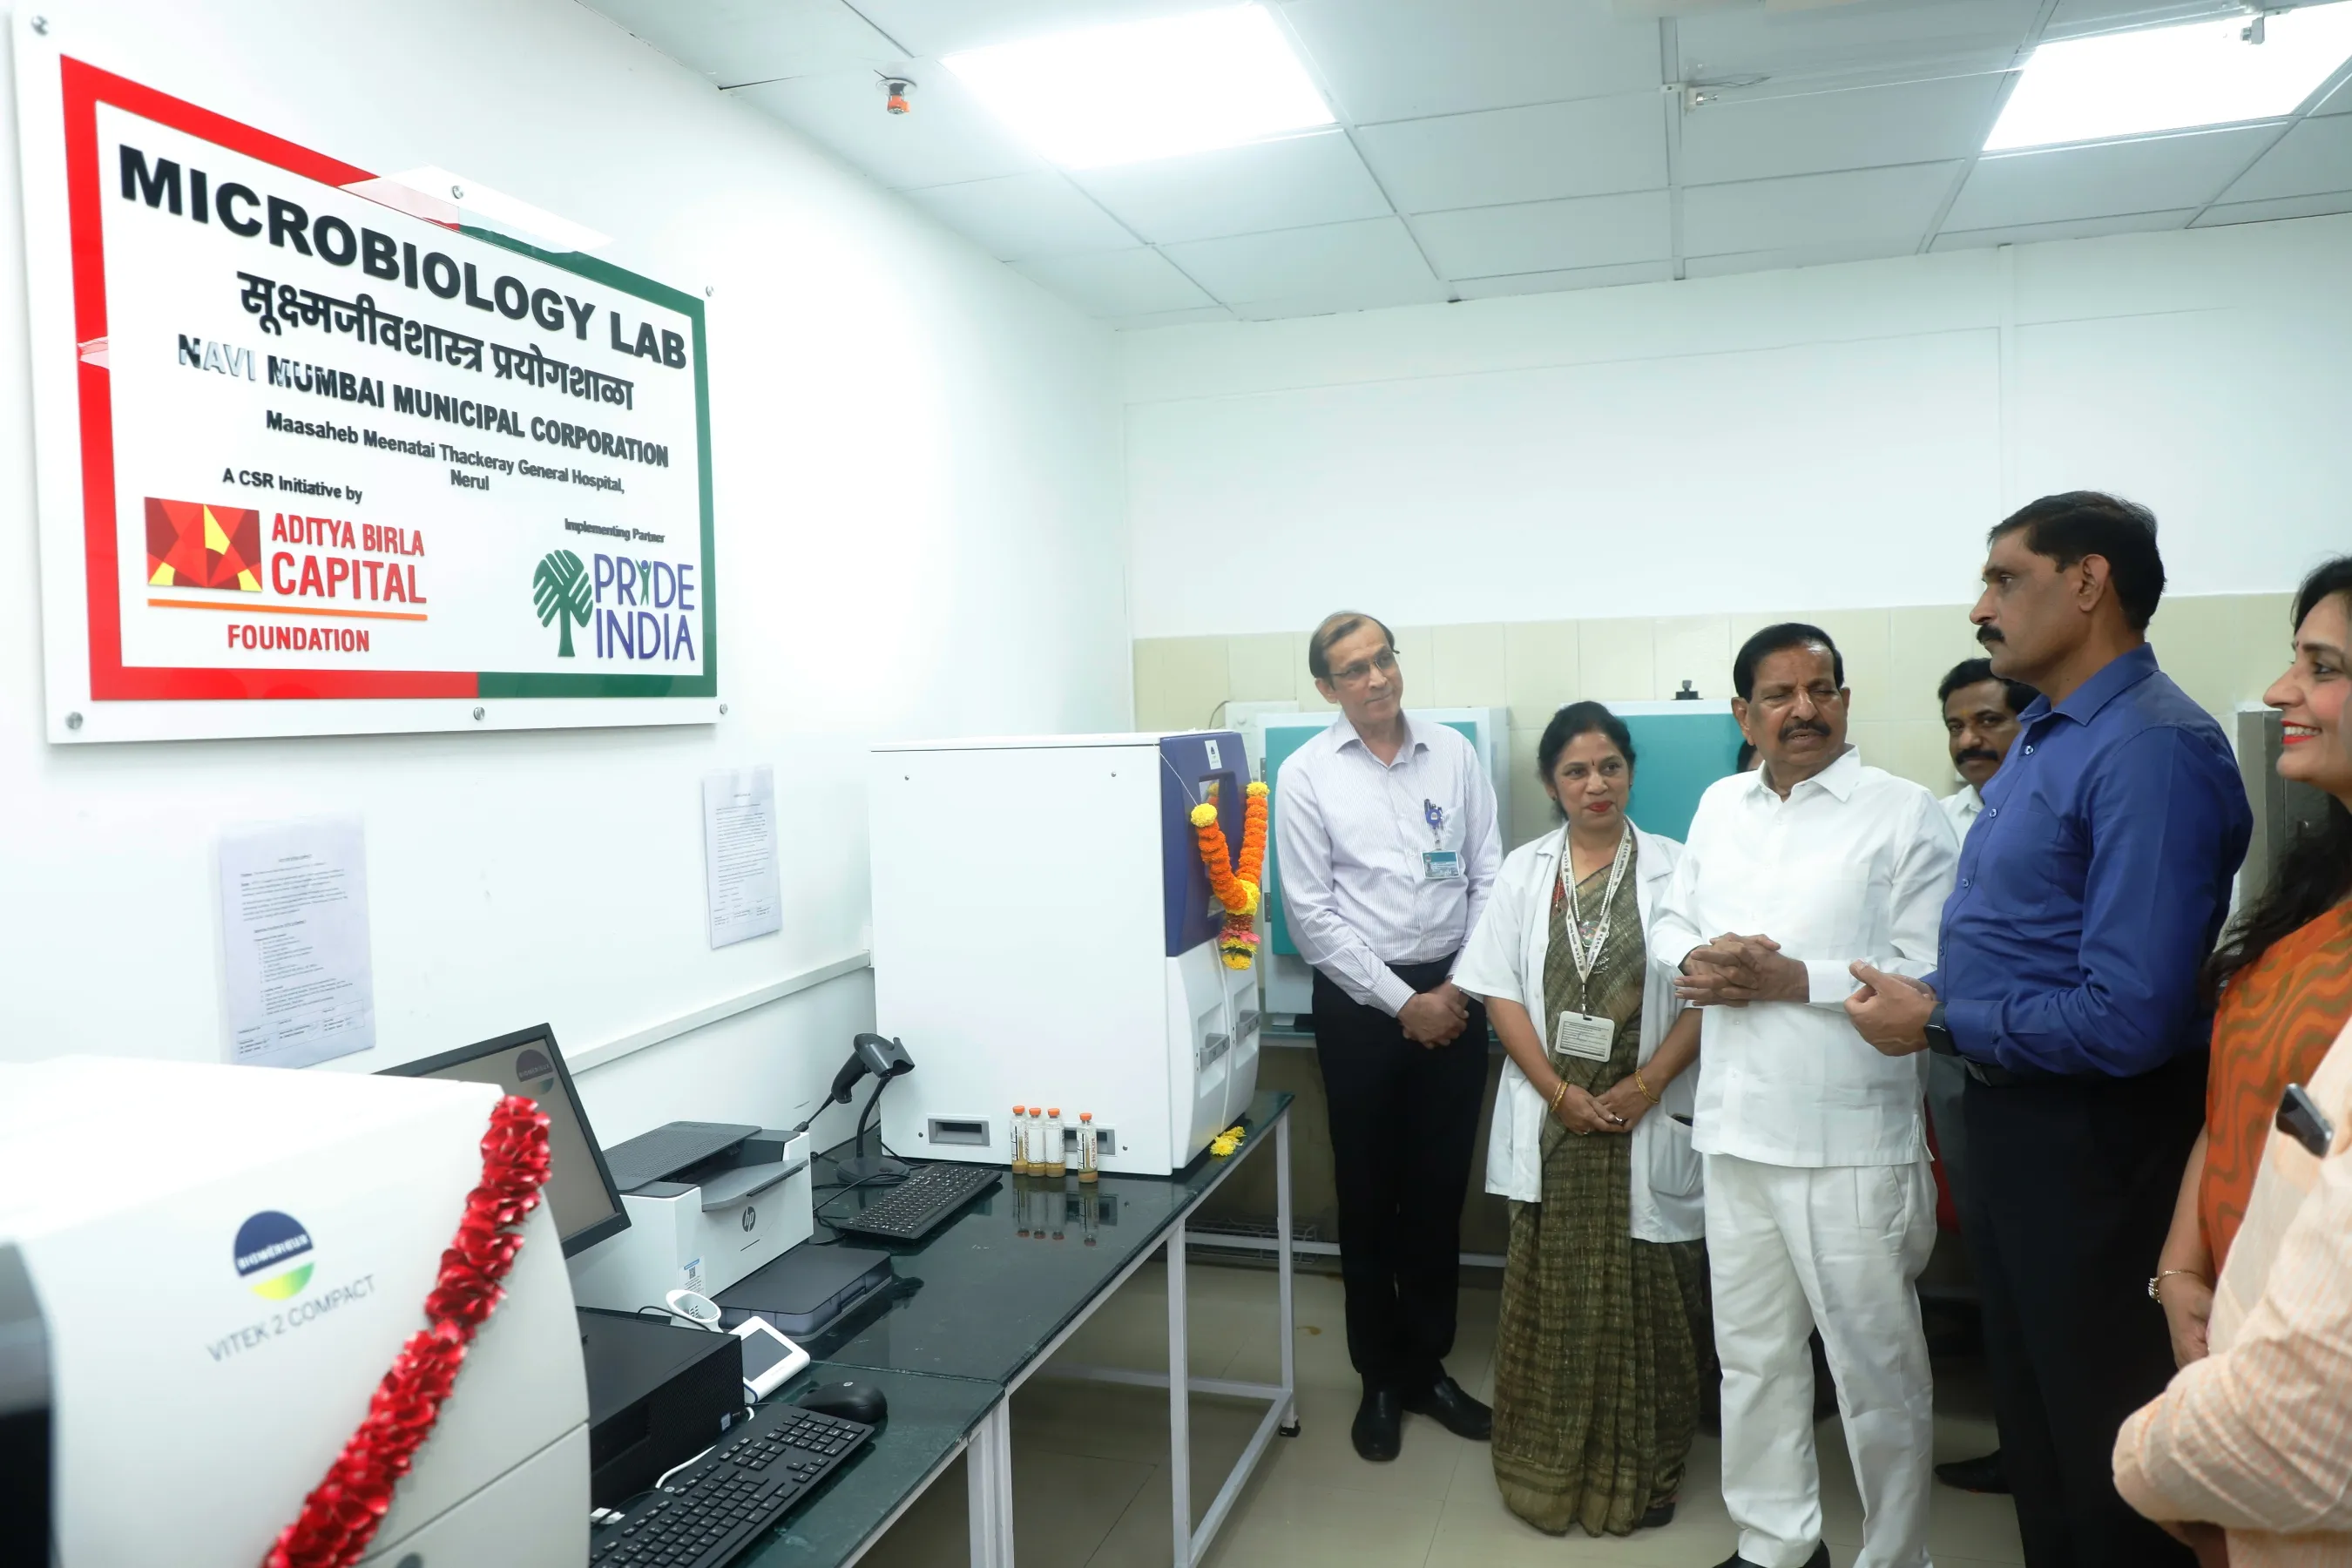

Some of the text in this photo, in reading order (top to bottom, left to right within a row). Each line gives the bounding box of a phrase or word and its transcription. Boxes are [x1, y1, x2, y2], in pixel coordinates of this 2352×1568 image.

[119, 144, 686, 369] MICROBIOLOGY LAB
[236, 270, 634, 410] सूक्ष्मजीवशास्त्र प्रयोगशाळा
[178, 333, 669, 468] NAVI MUMBAI MUNICIPAL CORPORATION
[266, 409, 625, 495] Maasaheb Meenatai Thackeray General Hospital,
[222, 467, 363, 504] A CSR Initiative by
[449, 469, 490, 490] Nerul
[272, 512, 425, 557] ADITYA BIRLA
[564, 517, 666, 544] Implementing Partner
[271, 551, 428, 604] CAPITAL
[594, 553, 695, 611] PRIDE
[227, 624, 370, 652] FOUNDATION
[596, 608, 696, 661] INDIA
[743, 1207, 755, 1232] hp
[205, 1274, 375, 1362] VITEK 2 COMPACT
